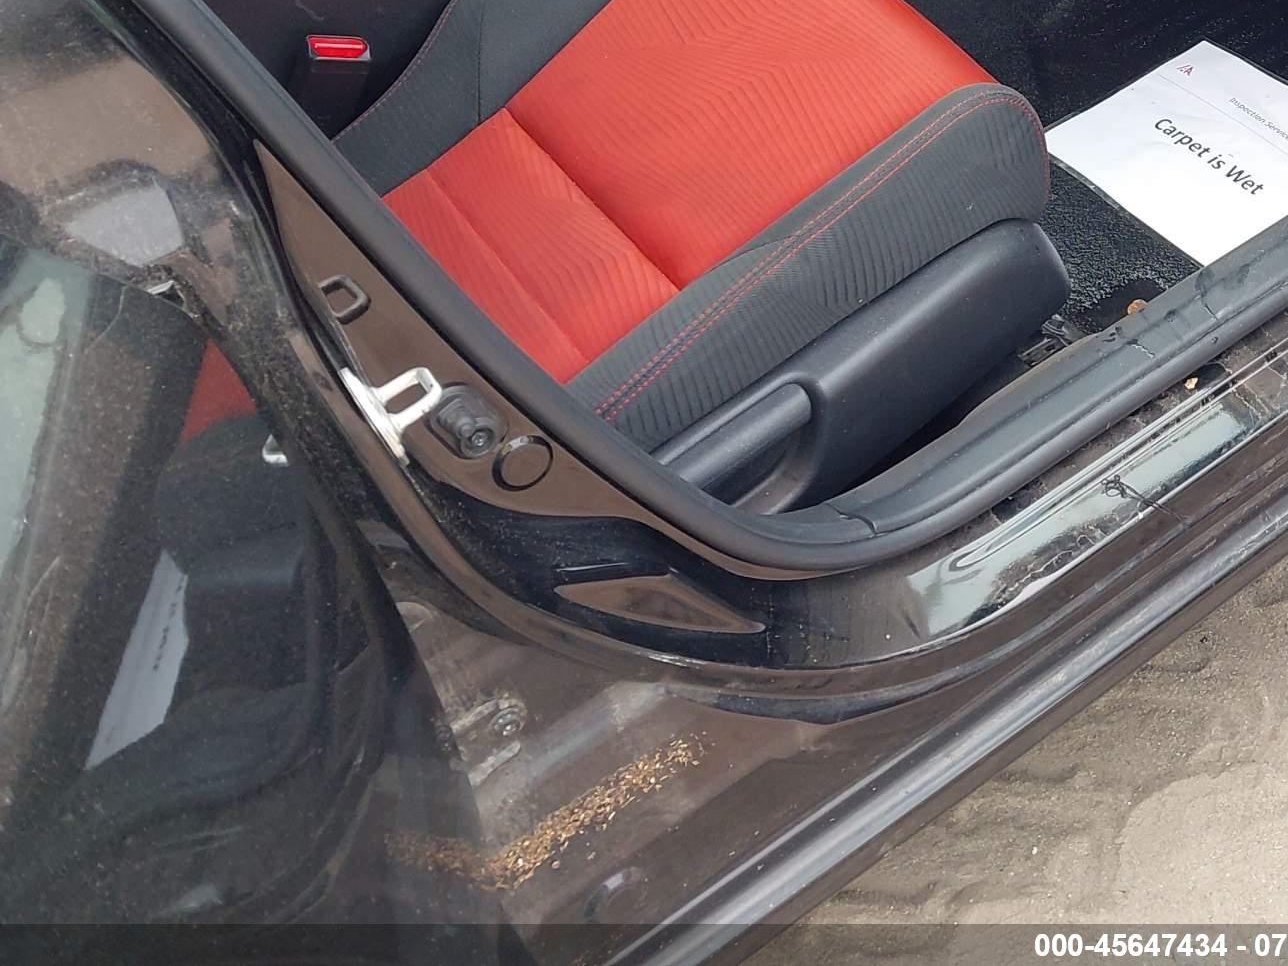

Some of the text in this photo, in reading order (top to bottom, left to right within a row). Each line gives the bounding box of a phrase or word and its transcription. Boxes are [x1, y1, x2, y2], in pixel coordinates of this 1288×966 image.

[1228, 97, 1266, 123] Inspection
[1154, 118, 1264, 195] Carpet is Wet
